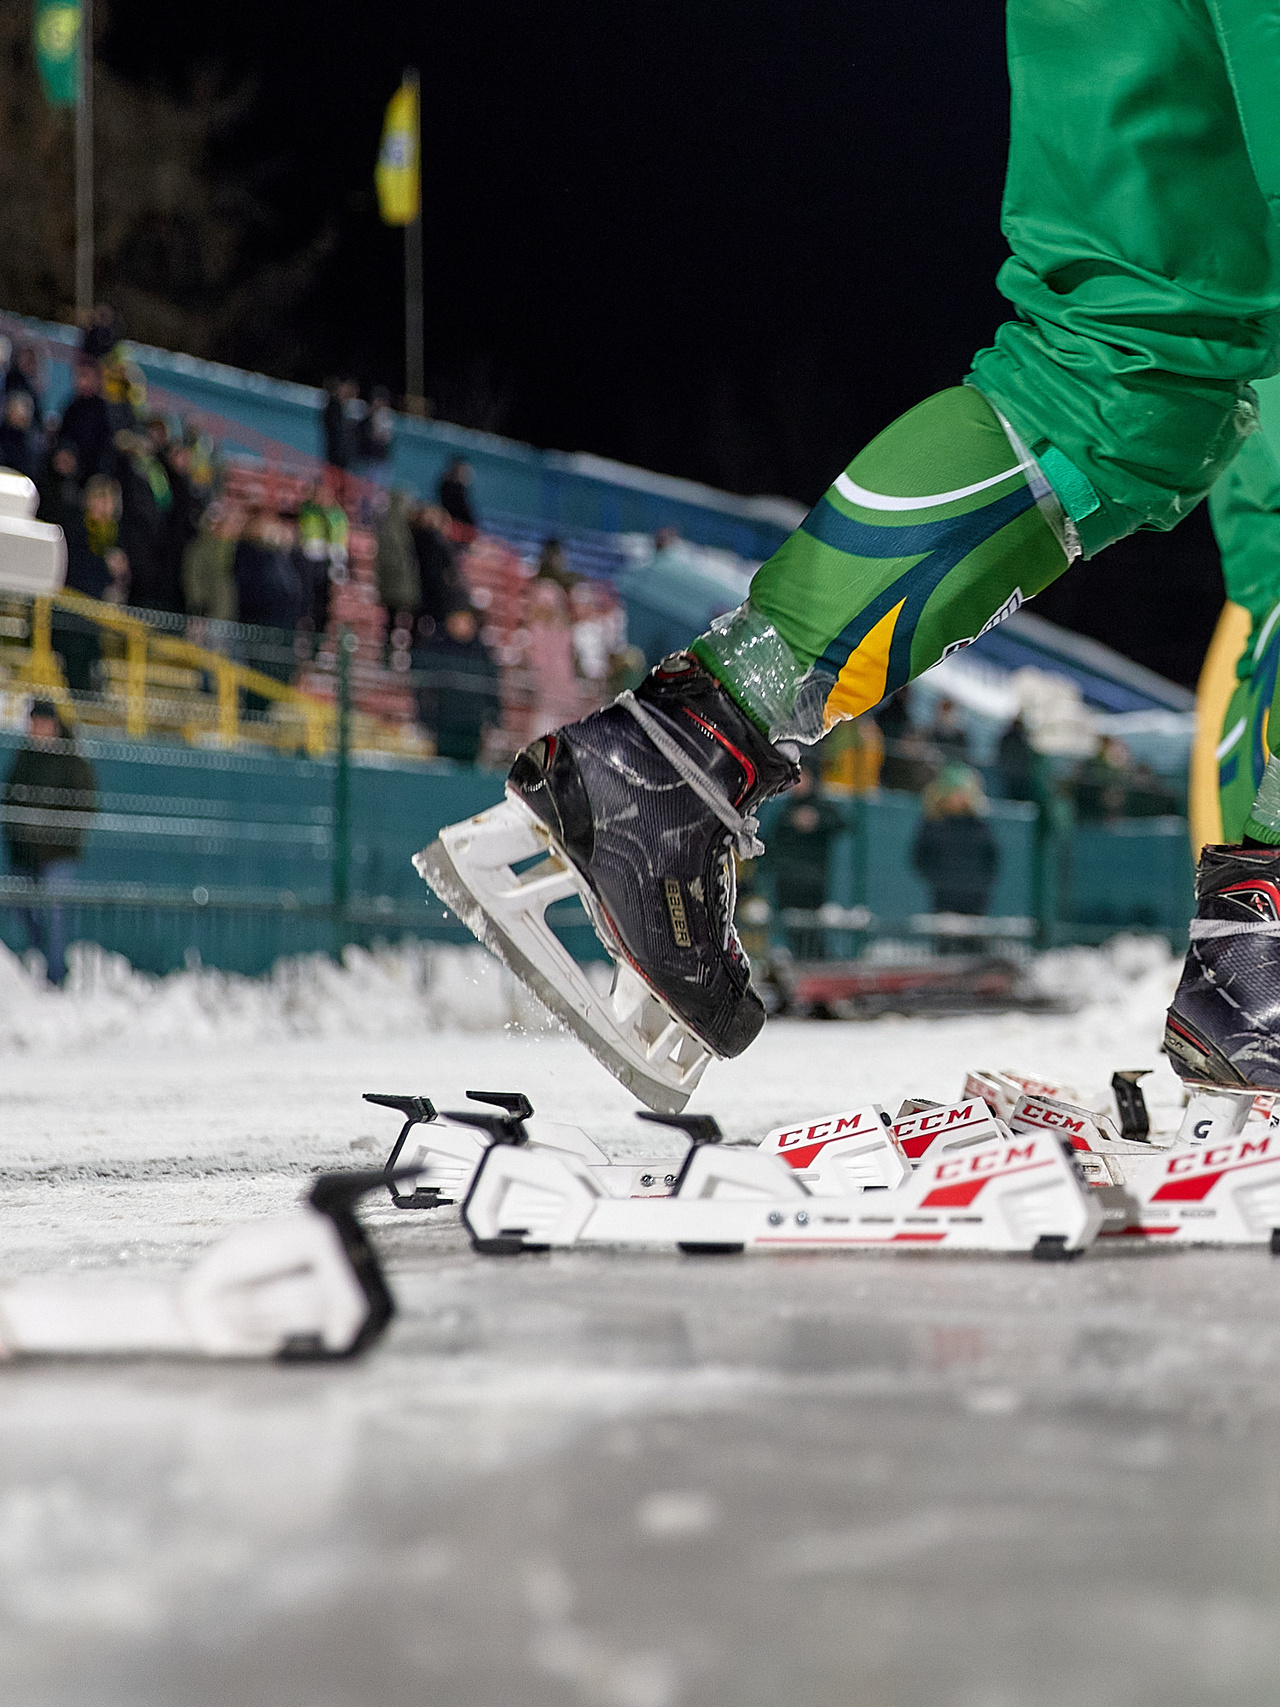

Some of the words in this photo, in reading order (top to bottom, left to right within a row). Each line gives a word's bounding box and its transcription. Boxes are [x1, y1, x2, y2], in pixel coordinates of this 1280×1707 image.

[666, 883, 689, 943] BAUER
[778, 1113, 862, 1147] CCM
[892, 1105, 973, 1137] CCM
[1022, 1103, 1085, 1133] CCM
[935, 1142, 1036, 1180] CCM
[1167, 1137, 1271, 1174] CCM
